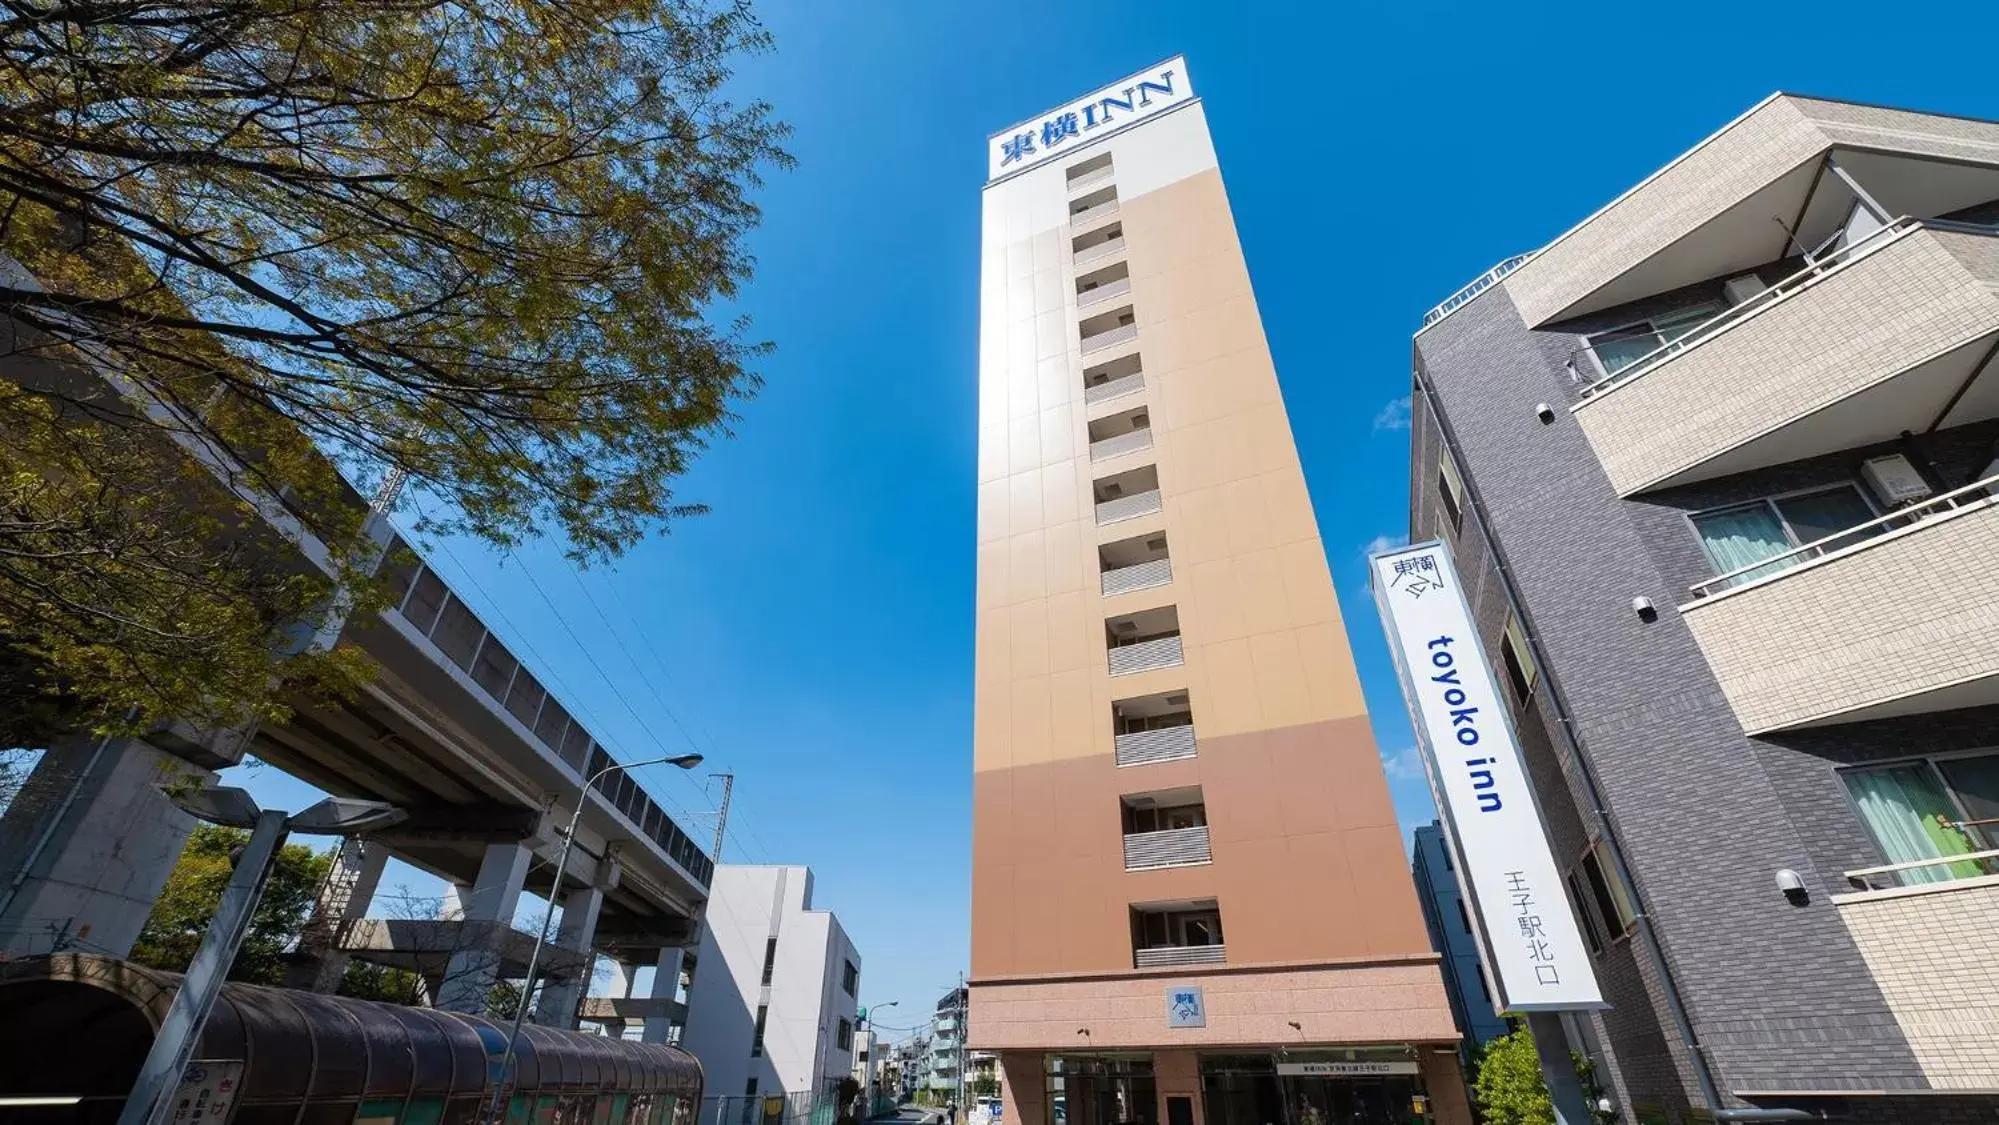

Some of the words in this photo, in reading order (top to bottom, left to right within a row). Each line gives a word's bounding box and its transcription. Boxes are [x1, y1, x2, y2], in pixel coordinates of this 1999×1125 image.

[1000, 69, 1175, 167] 東横INN
[1428, 634, 1480, 746] toyoko
[1466, 756, 1503, 813] inn
[1504, 870, 1560, 986] 王子駅北口
